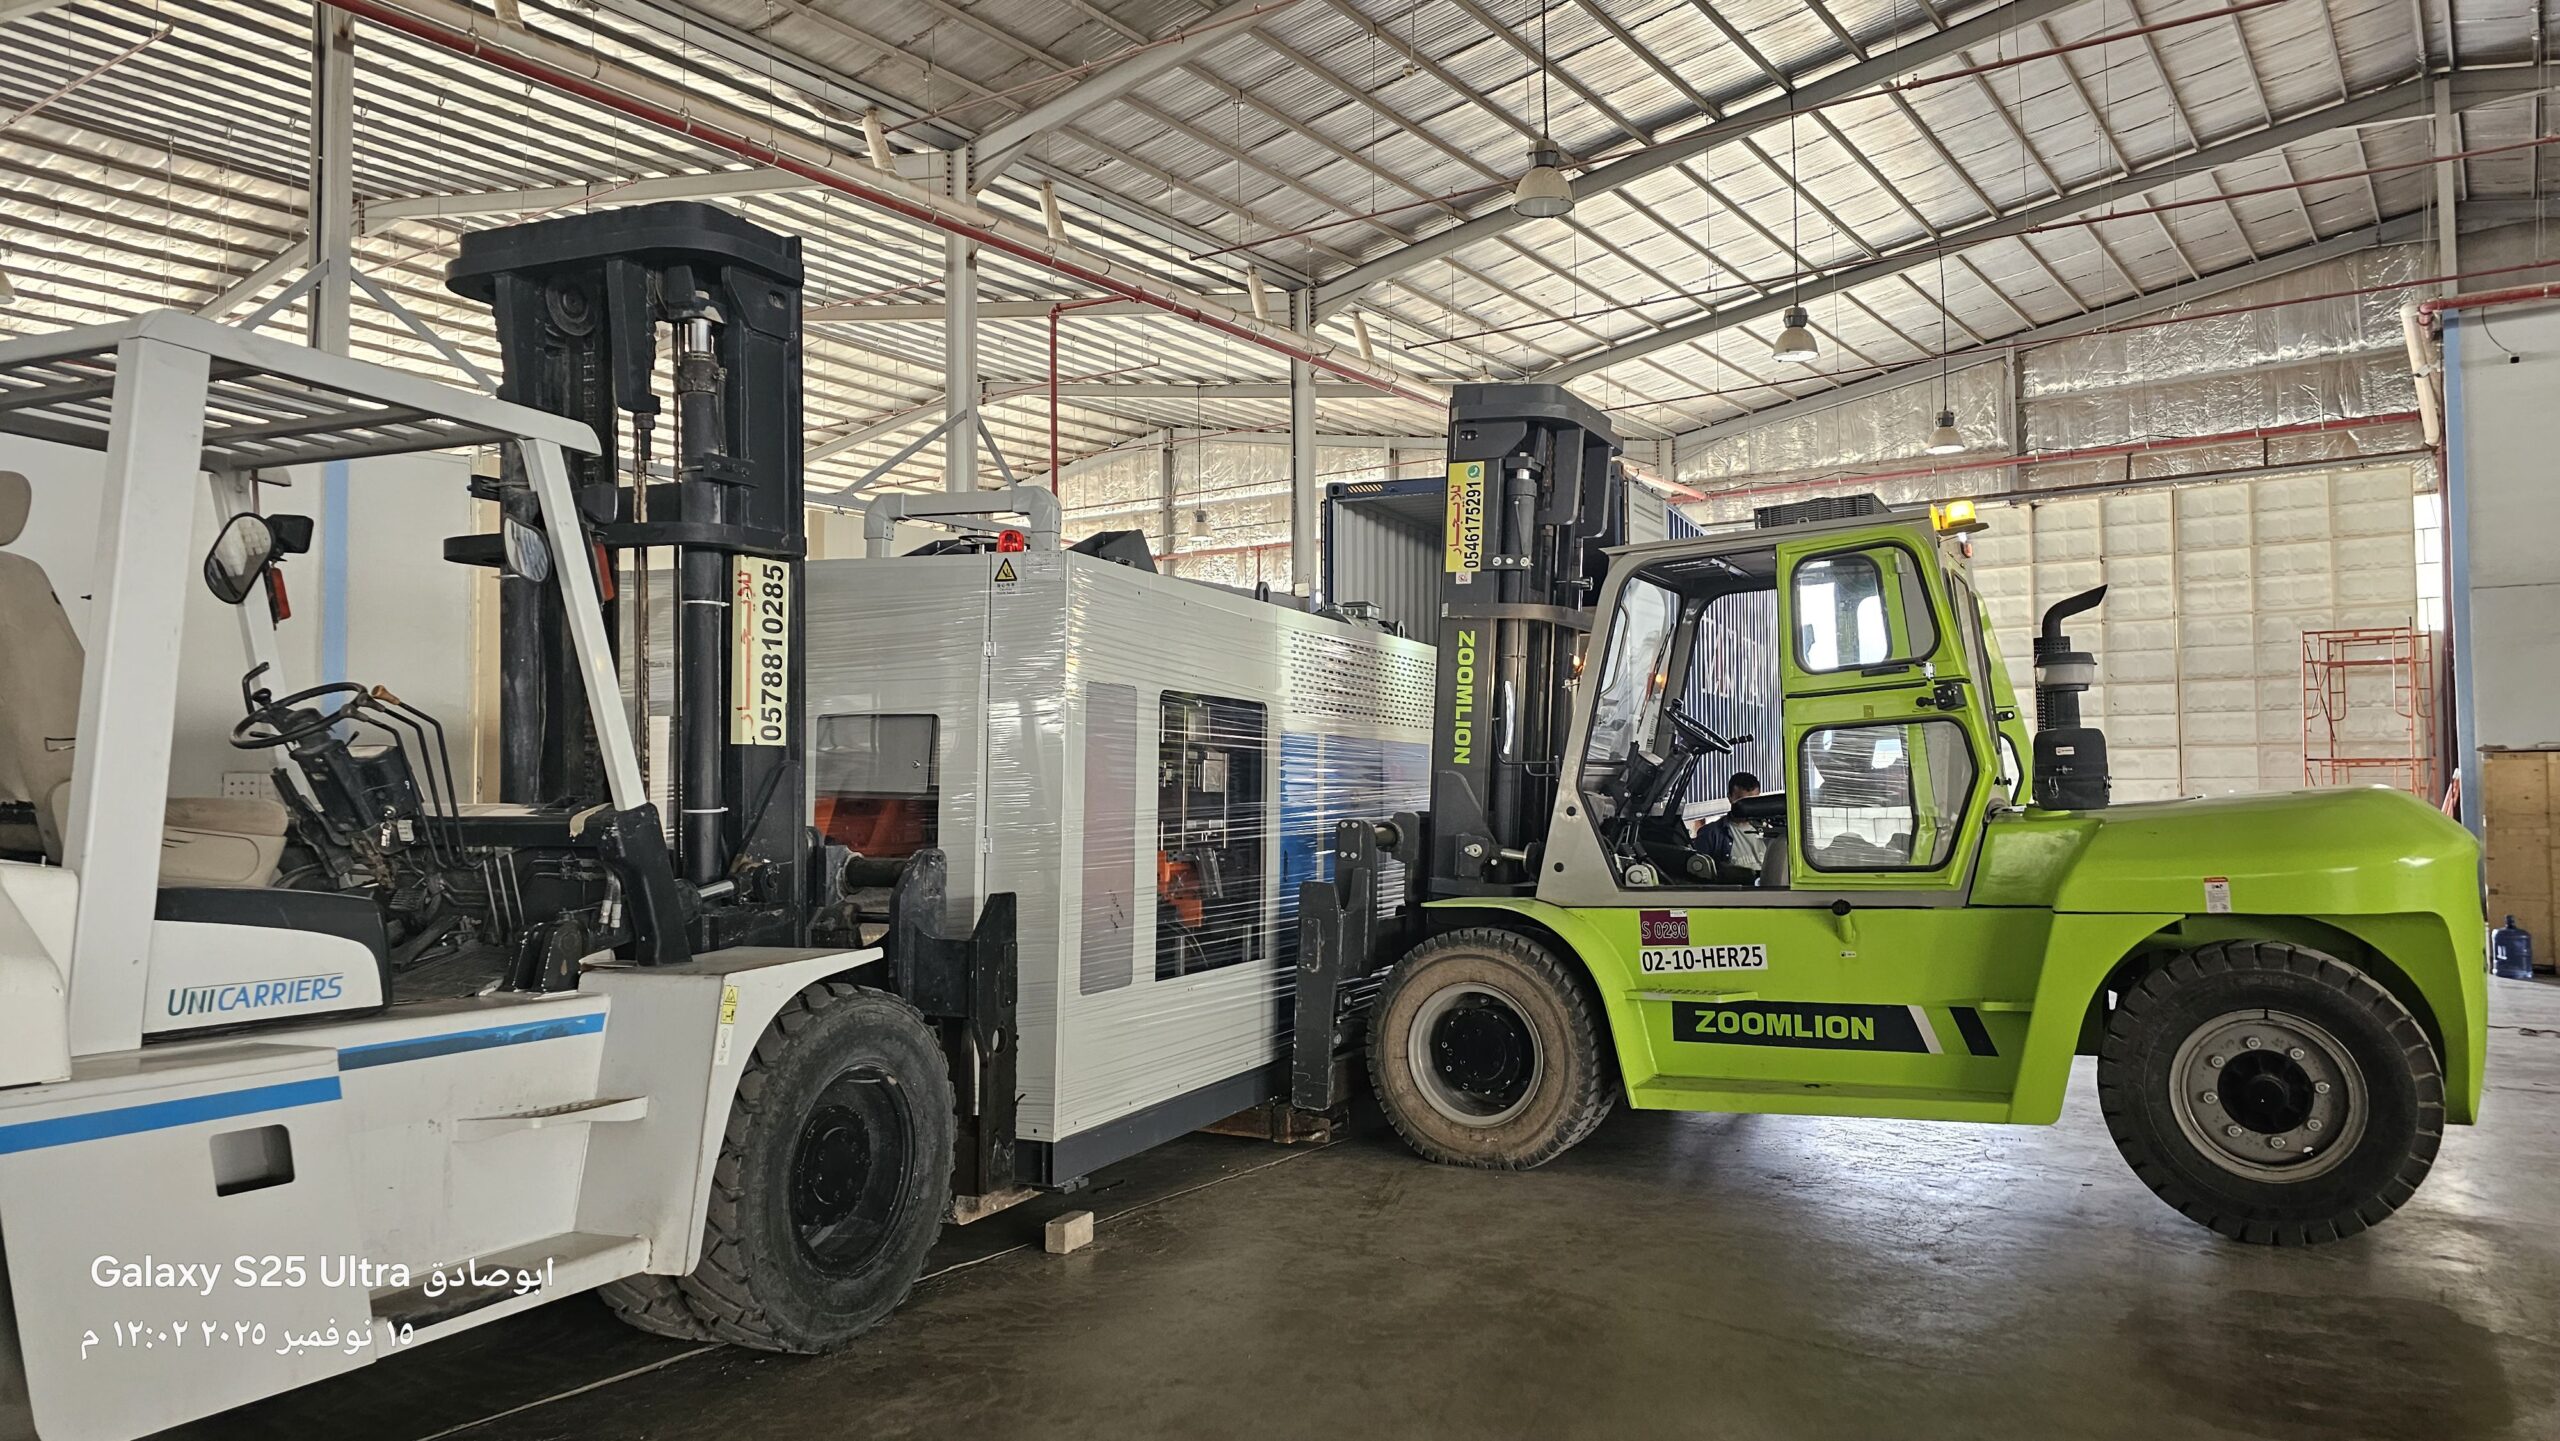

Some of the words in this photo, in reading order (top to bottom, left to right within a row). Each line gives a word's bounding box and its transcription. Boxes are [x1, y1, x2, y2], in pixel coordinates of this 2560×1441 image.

[1464, 482, 1481, 568] 0546175291
[761, 564, 784, 741] 0578810285
[1453, 630, 1475, 764] ZOOMLION
[1641, 921, 1651, 939] S
[1654, 921, 1688, 939] 0290
[1642, 946, 1763, 971] 02-10-HER25
[168, 975, 344, 1016] UNICARRIERS
[1695, 1010, 1875, 1041] ZOOMLION
